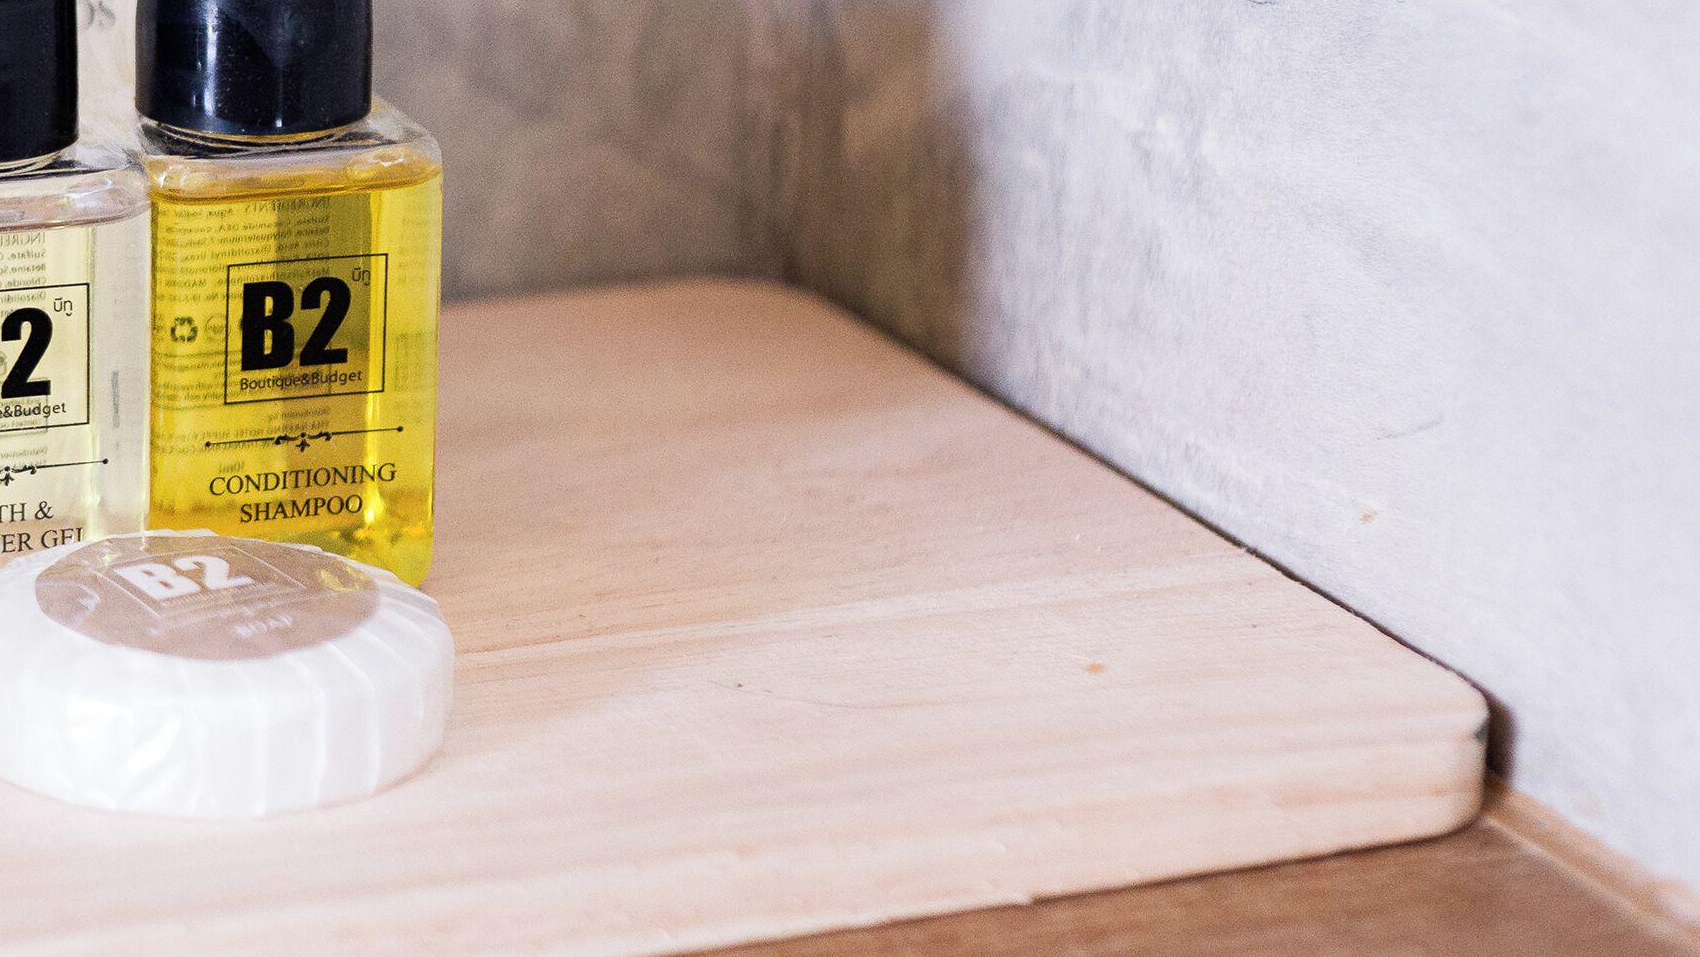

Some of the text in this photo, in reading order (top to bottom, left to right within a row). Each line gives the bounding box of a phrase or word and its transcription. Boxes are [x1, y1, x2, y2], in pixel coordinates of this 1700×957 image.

[241, 277, 351, 371] B2
[240, 370, 364, 390] Boutique&Budget
[209, 462, 396, 496] CONDITIONING
[34, 500, 54, 520] &
[240, 494, 363, 523] SHAMPOO
[113, 555, 254, 600] B2
